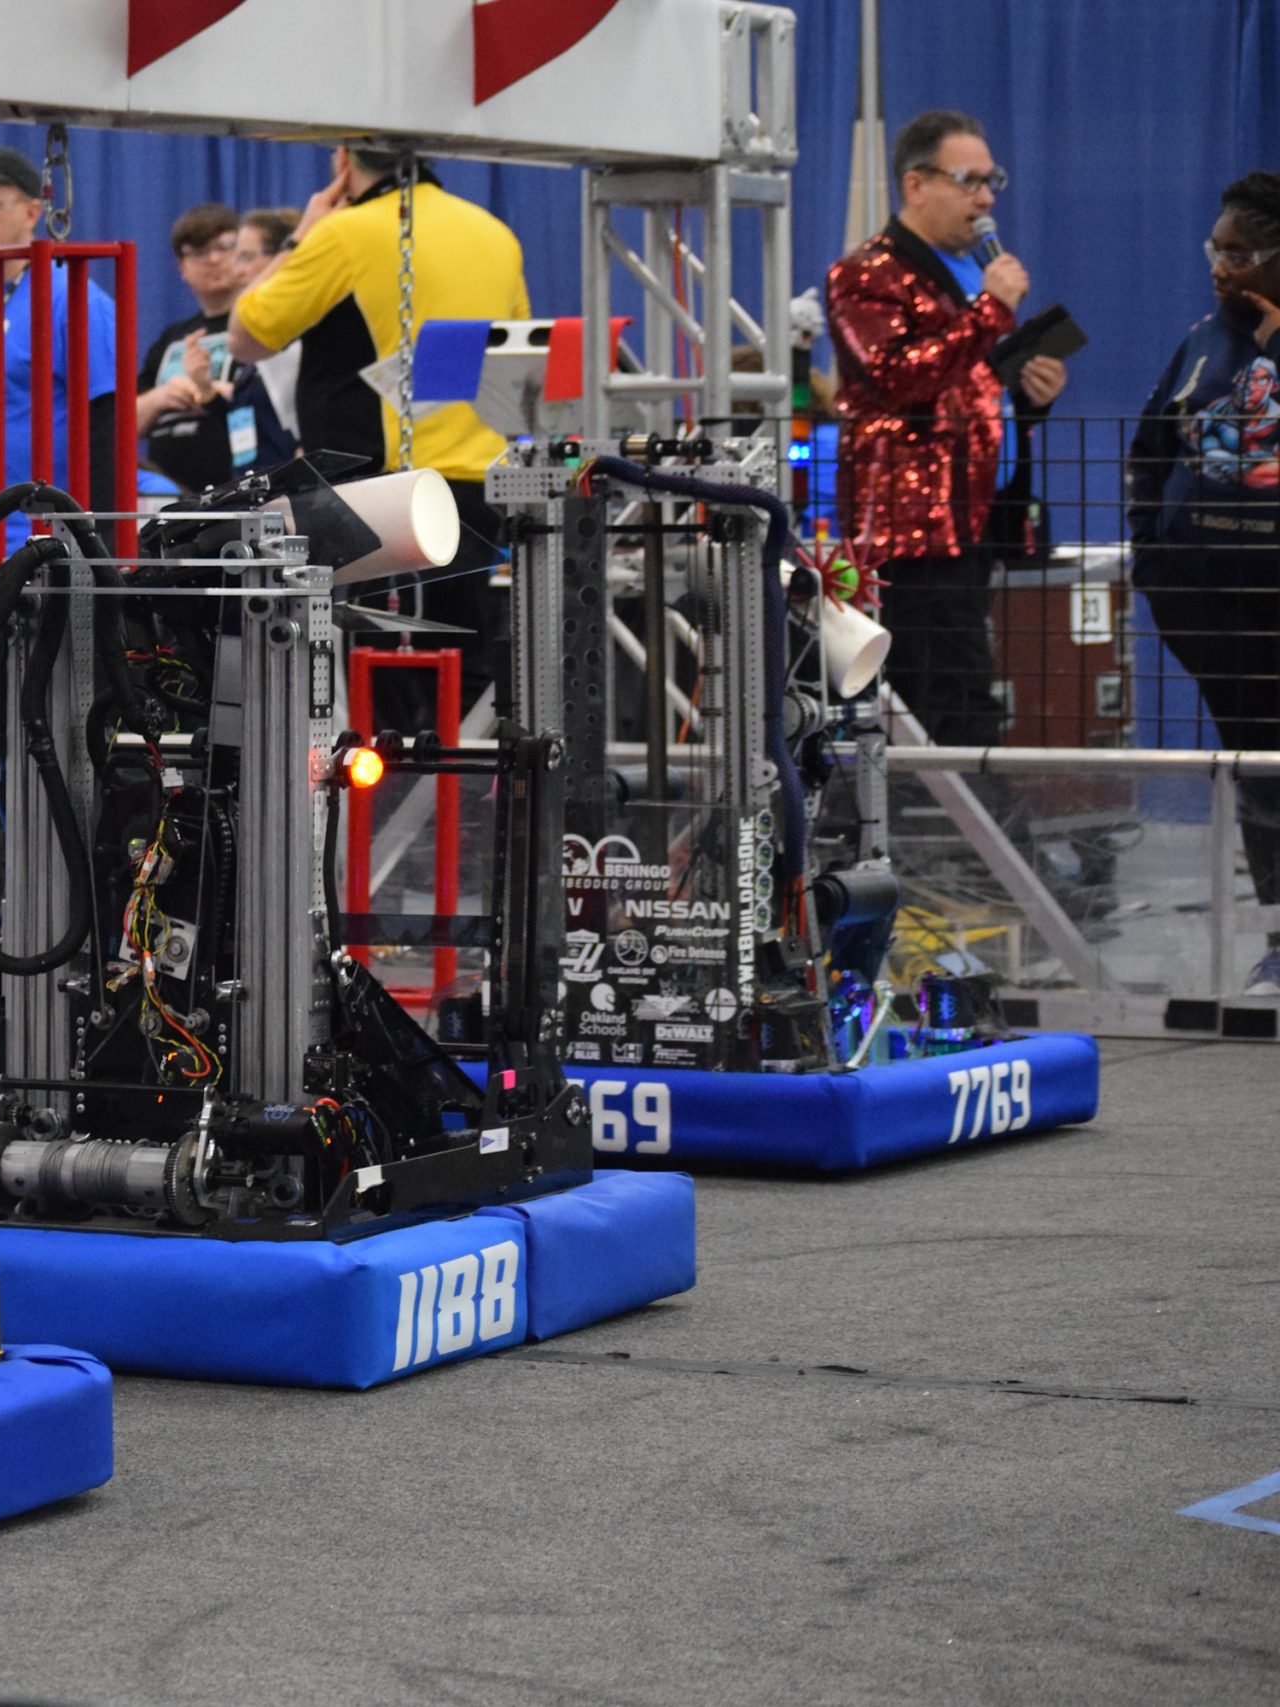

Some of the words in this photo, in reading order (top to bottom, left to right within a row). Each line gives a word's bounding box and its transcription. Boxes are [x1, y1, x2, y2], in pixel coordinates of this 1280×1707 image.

[604, 864, 671, 878] BENINGO
[624, 879, 671, 891] GROUP
[625, 899, 731, 920] NISSAN
[738, 816, 755, 1007] #WEBUILDASONE
[580, 1011, 627, 1025] Oakland
[579, 1022, 627, 1037] Schools
[947, 1059, 1031, 1145] 7769
[392, 1240, 519, 1372] 1188
